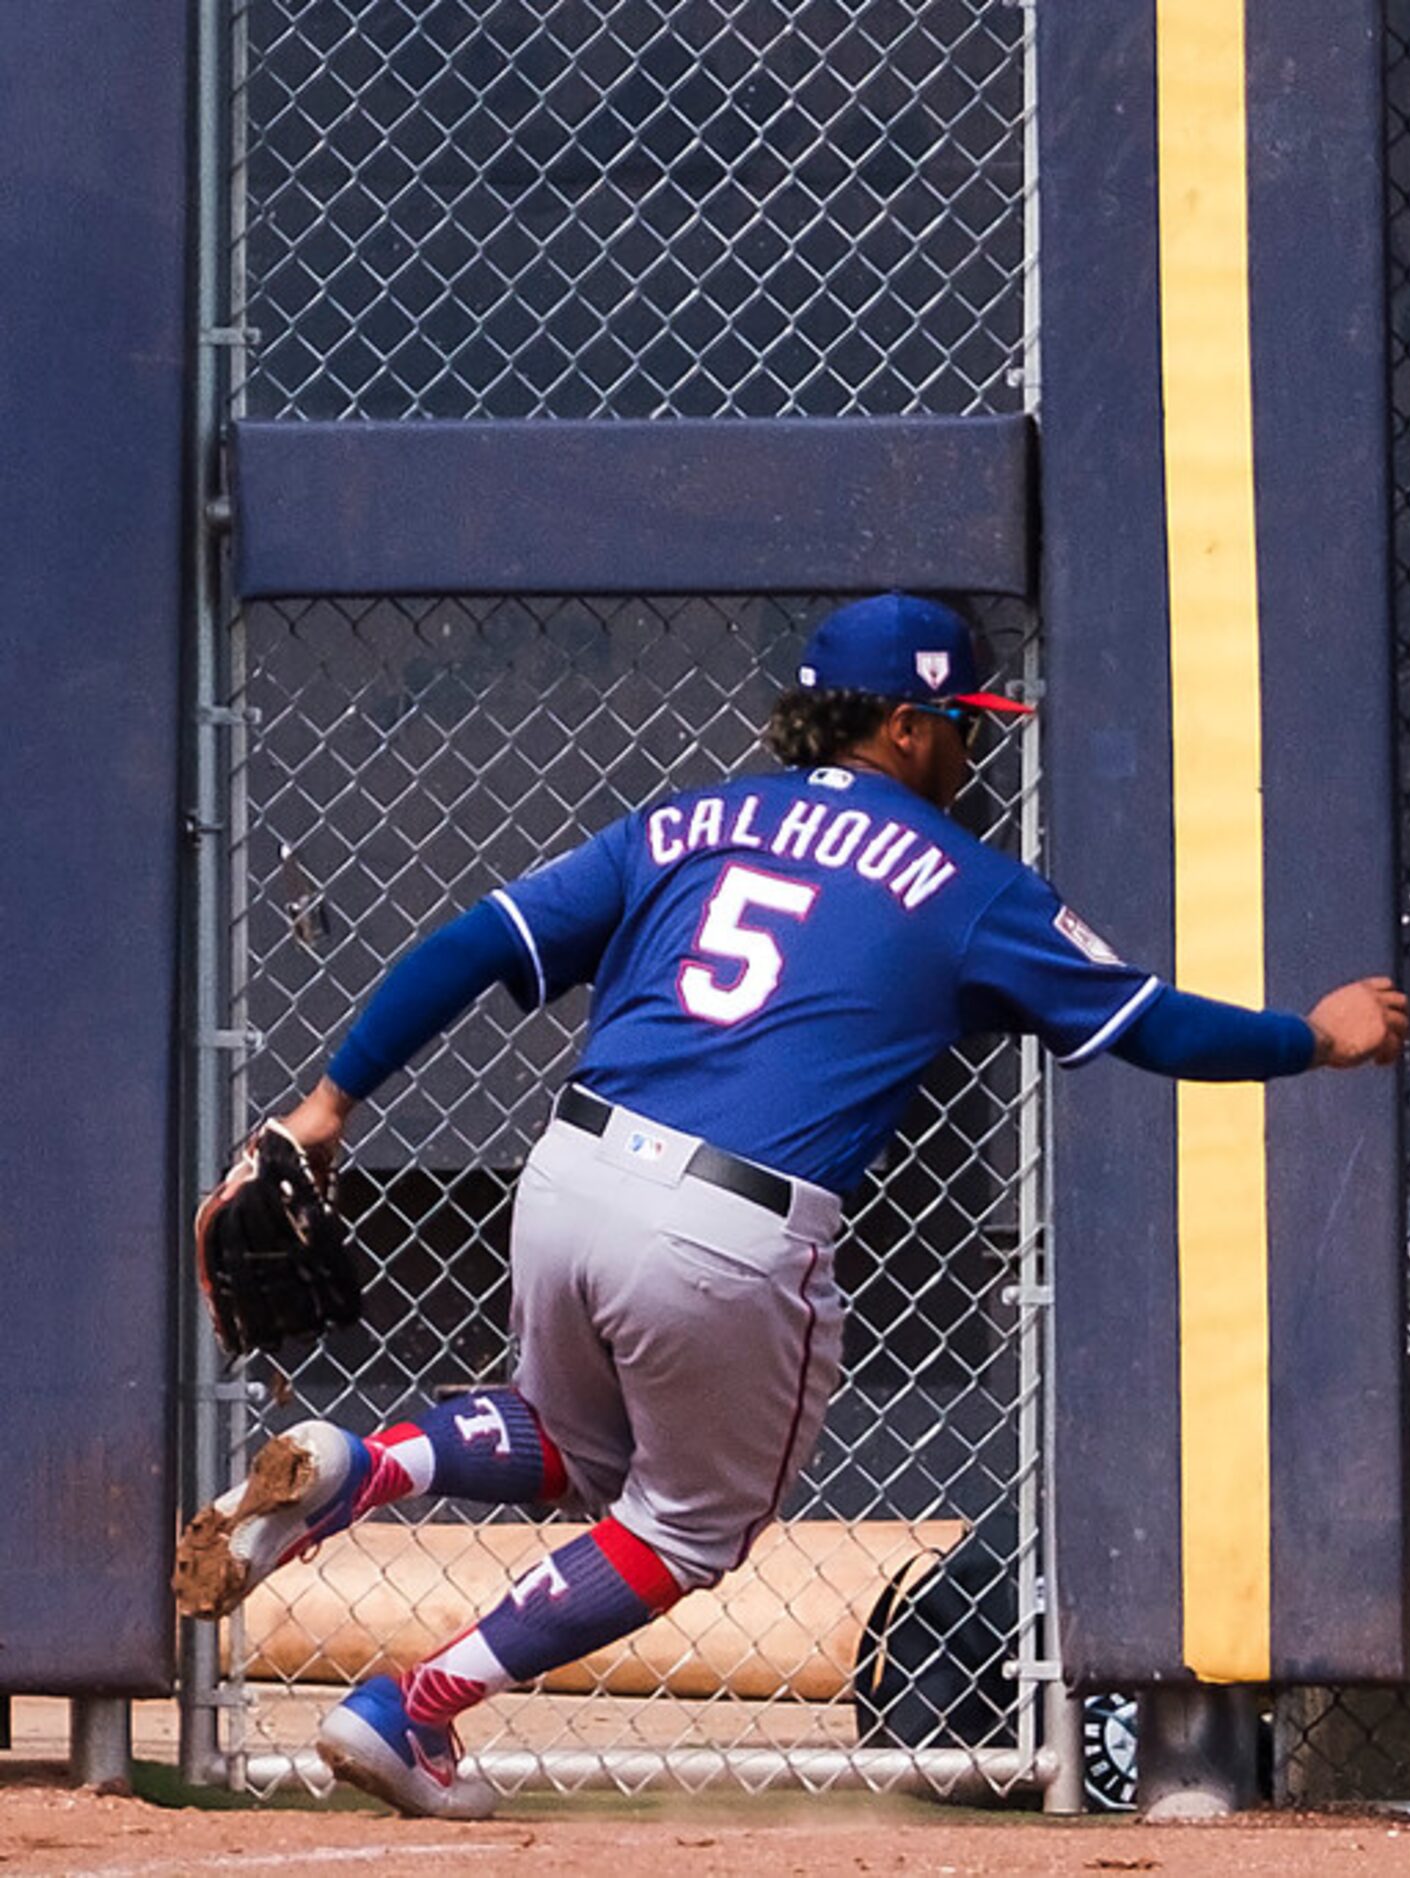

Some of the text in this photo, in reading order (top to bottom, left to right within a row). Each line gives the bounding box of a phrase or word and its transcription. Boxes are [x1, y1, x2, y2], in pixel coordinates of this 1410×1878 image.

[648, 796, 957, 911] CALHOUN
[676, 861, 820, 1028] 5
[454, 1396, 511, 1459] T
